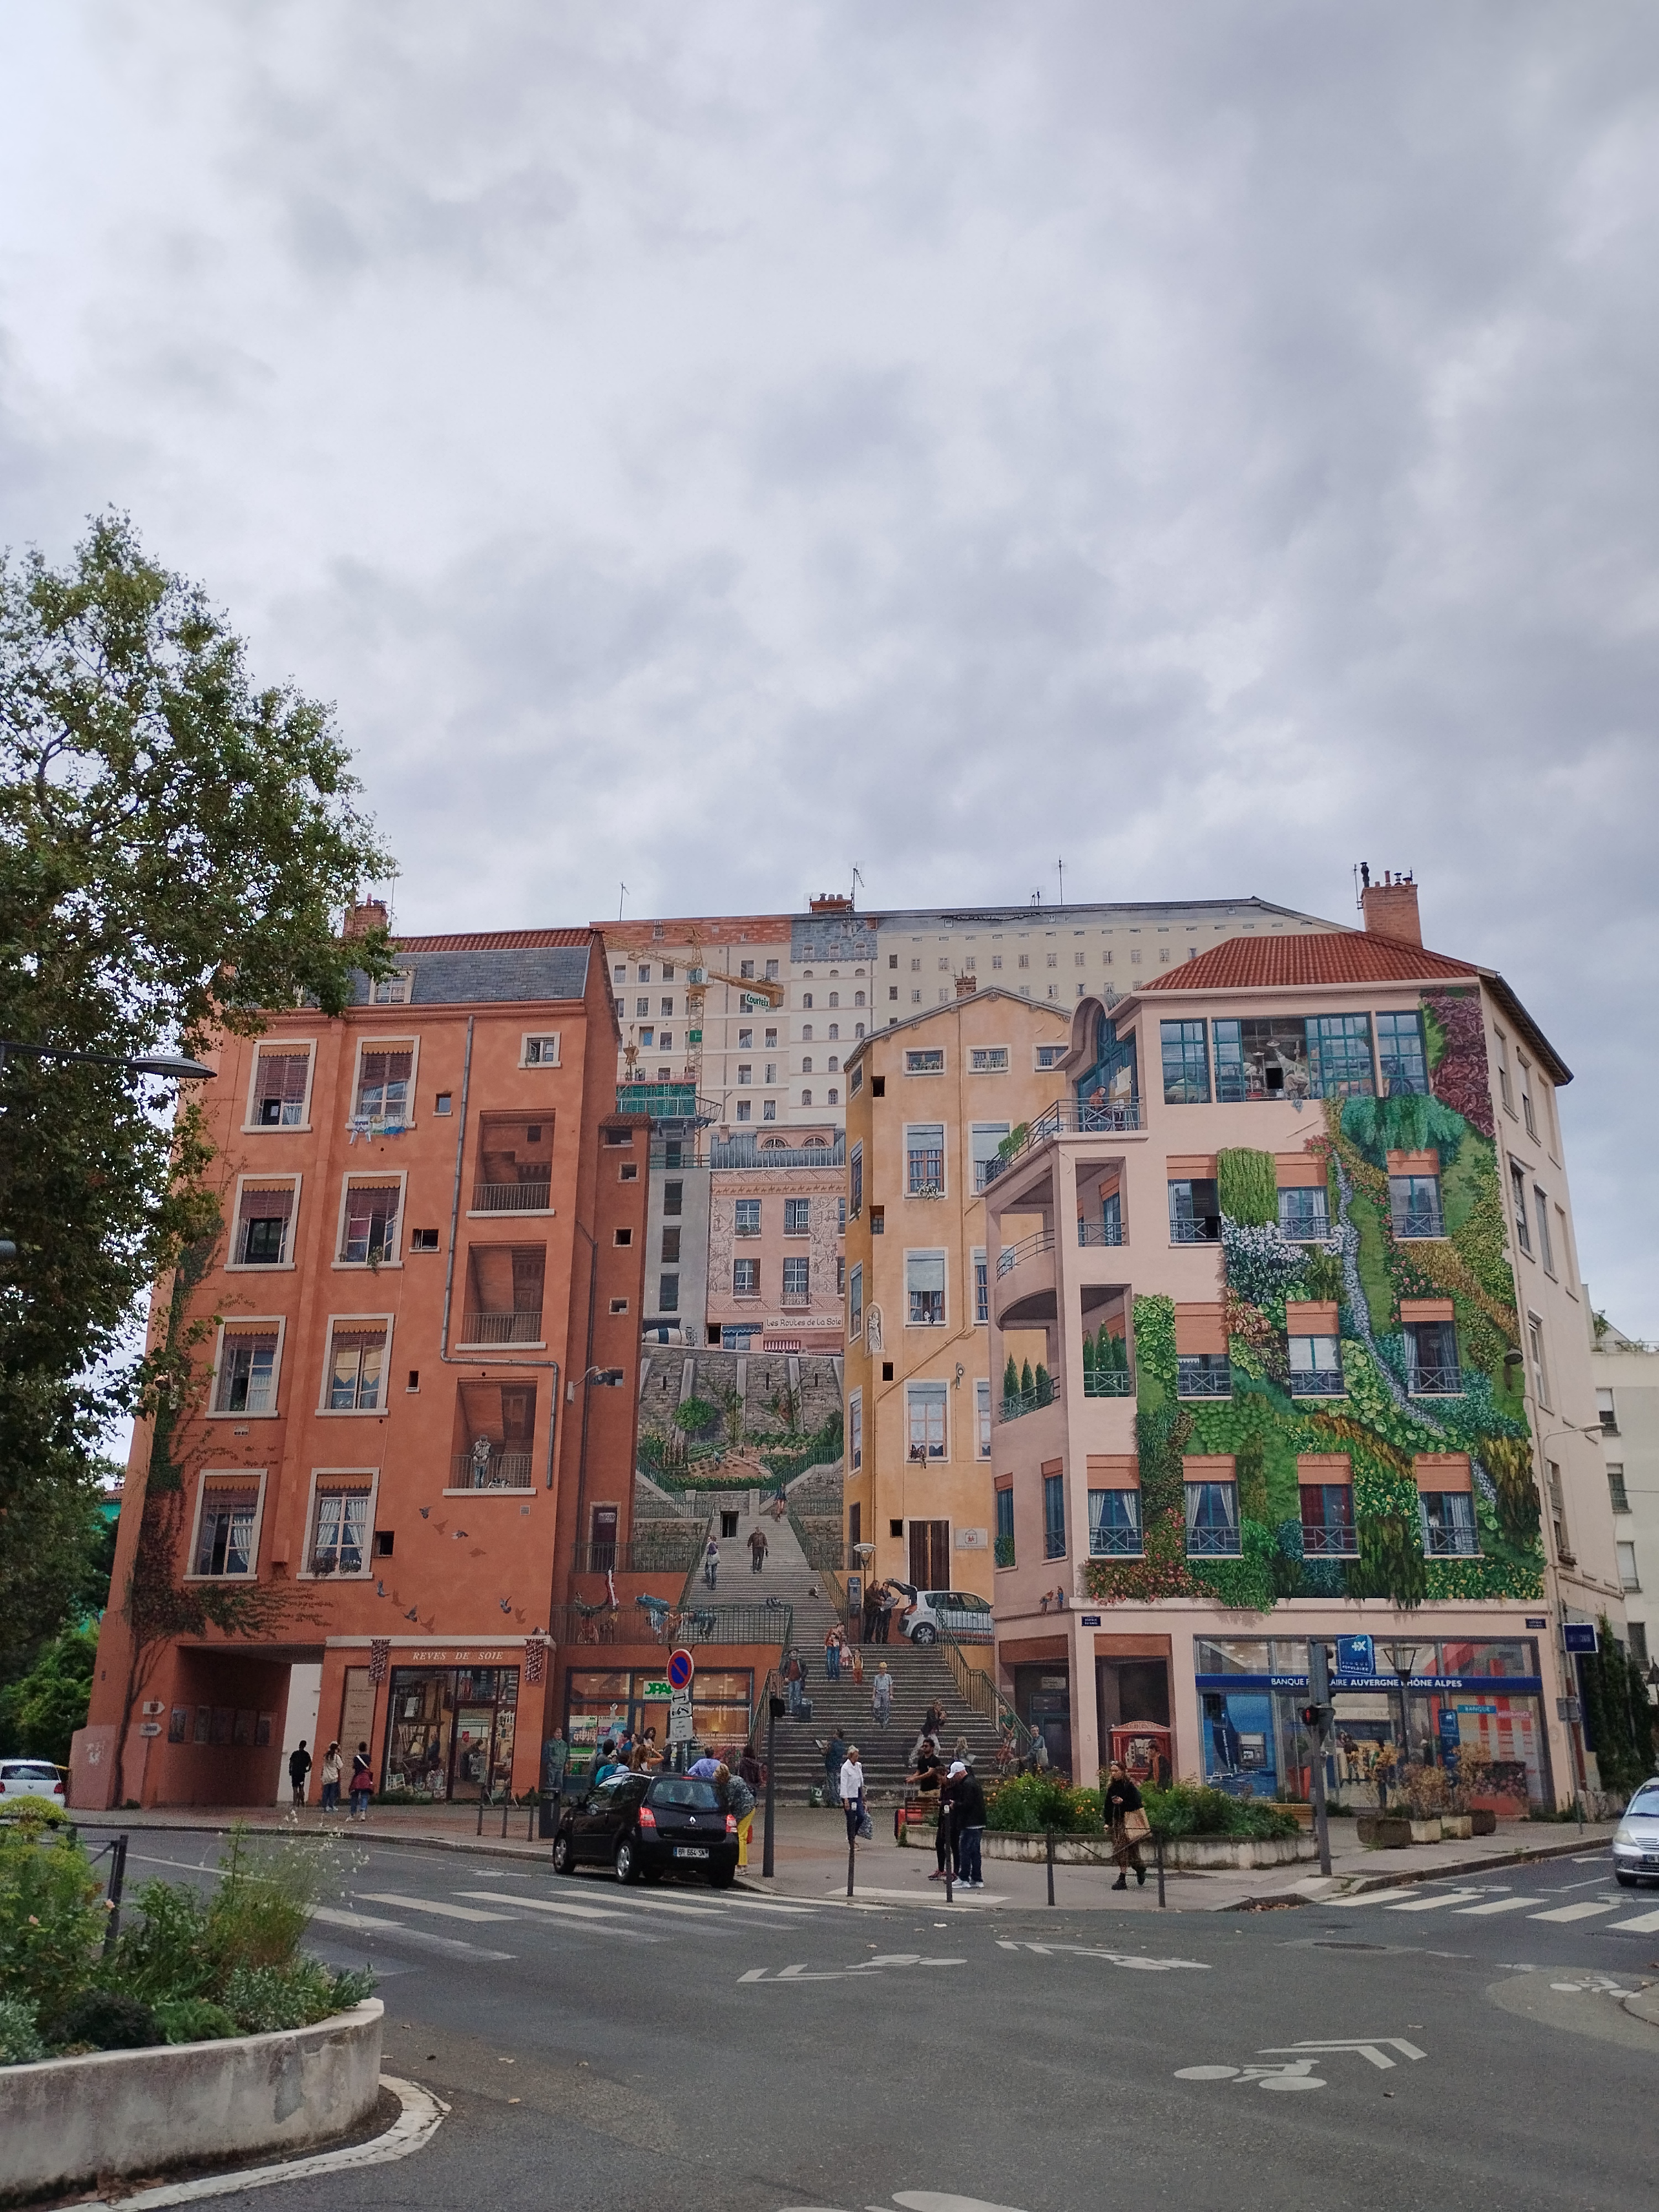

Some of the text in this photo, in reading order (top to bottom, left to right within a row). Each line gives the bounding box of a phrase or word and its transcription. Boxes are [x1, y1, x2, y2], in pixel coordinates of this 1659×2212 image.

[747, 993, 769, 1008] Courteix
[826, 1317, 841, 1326] Soie
[478, 1651, 503, 1660] SOIE
